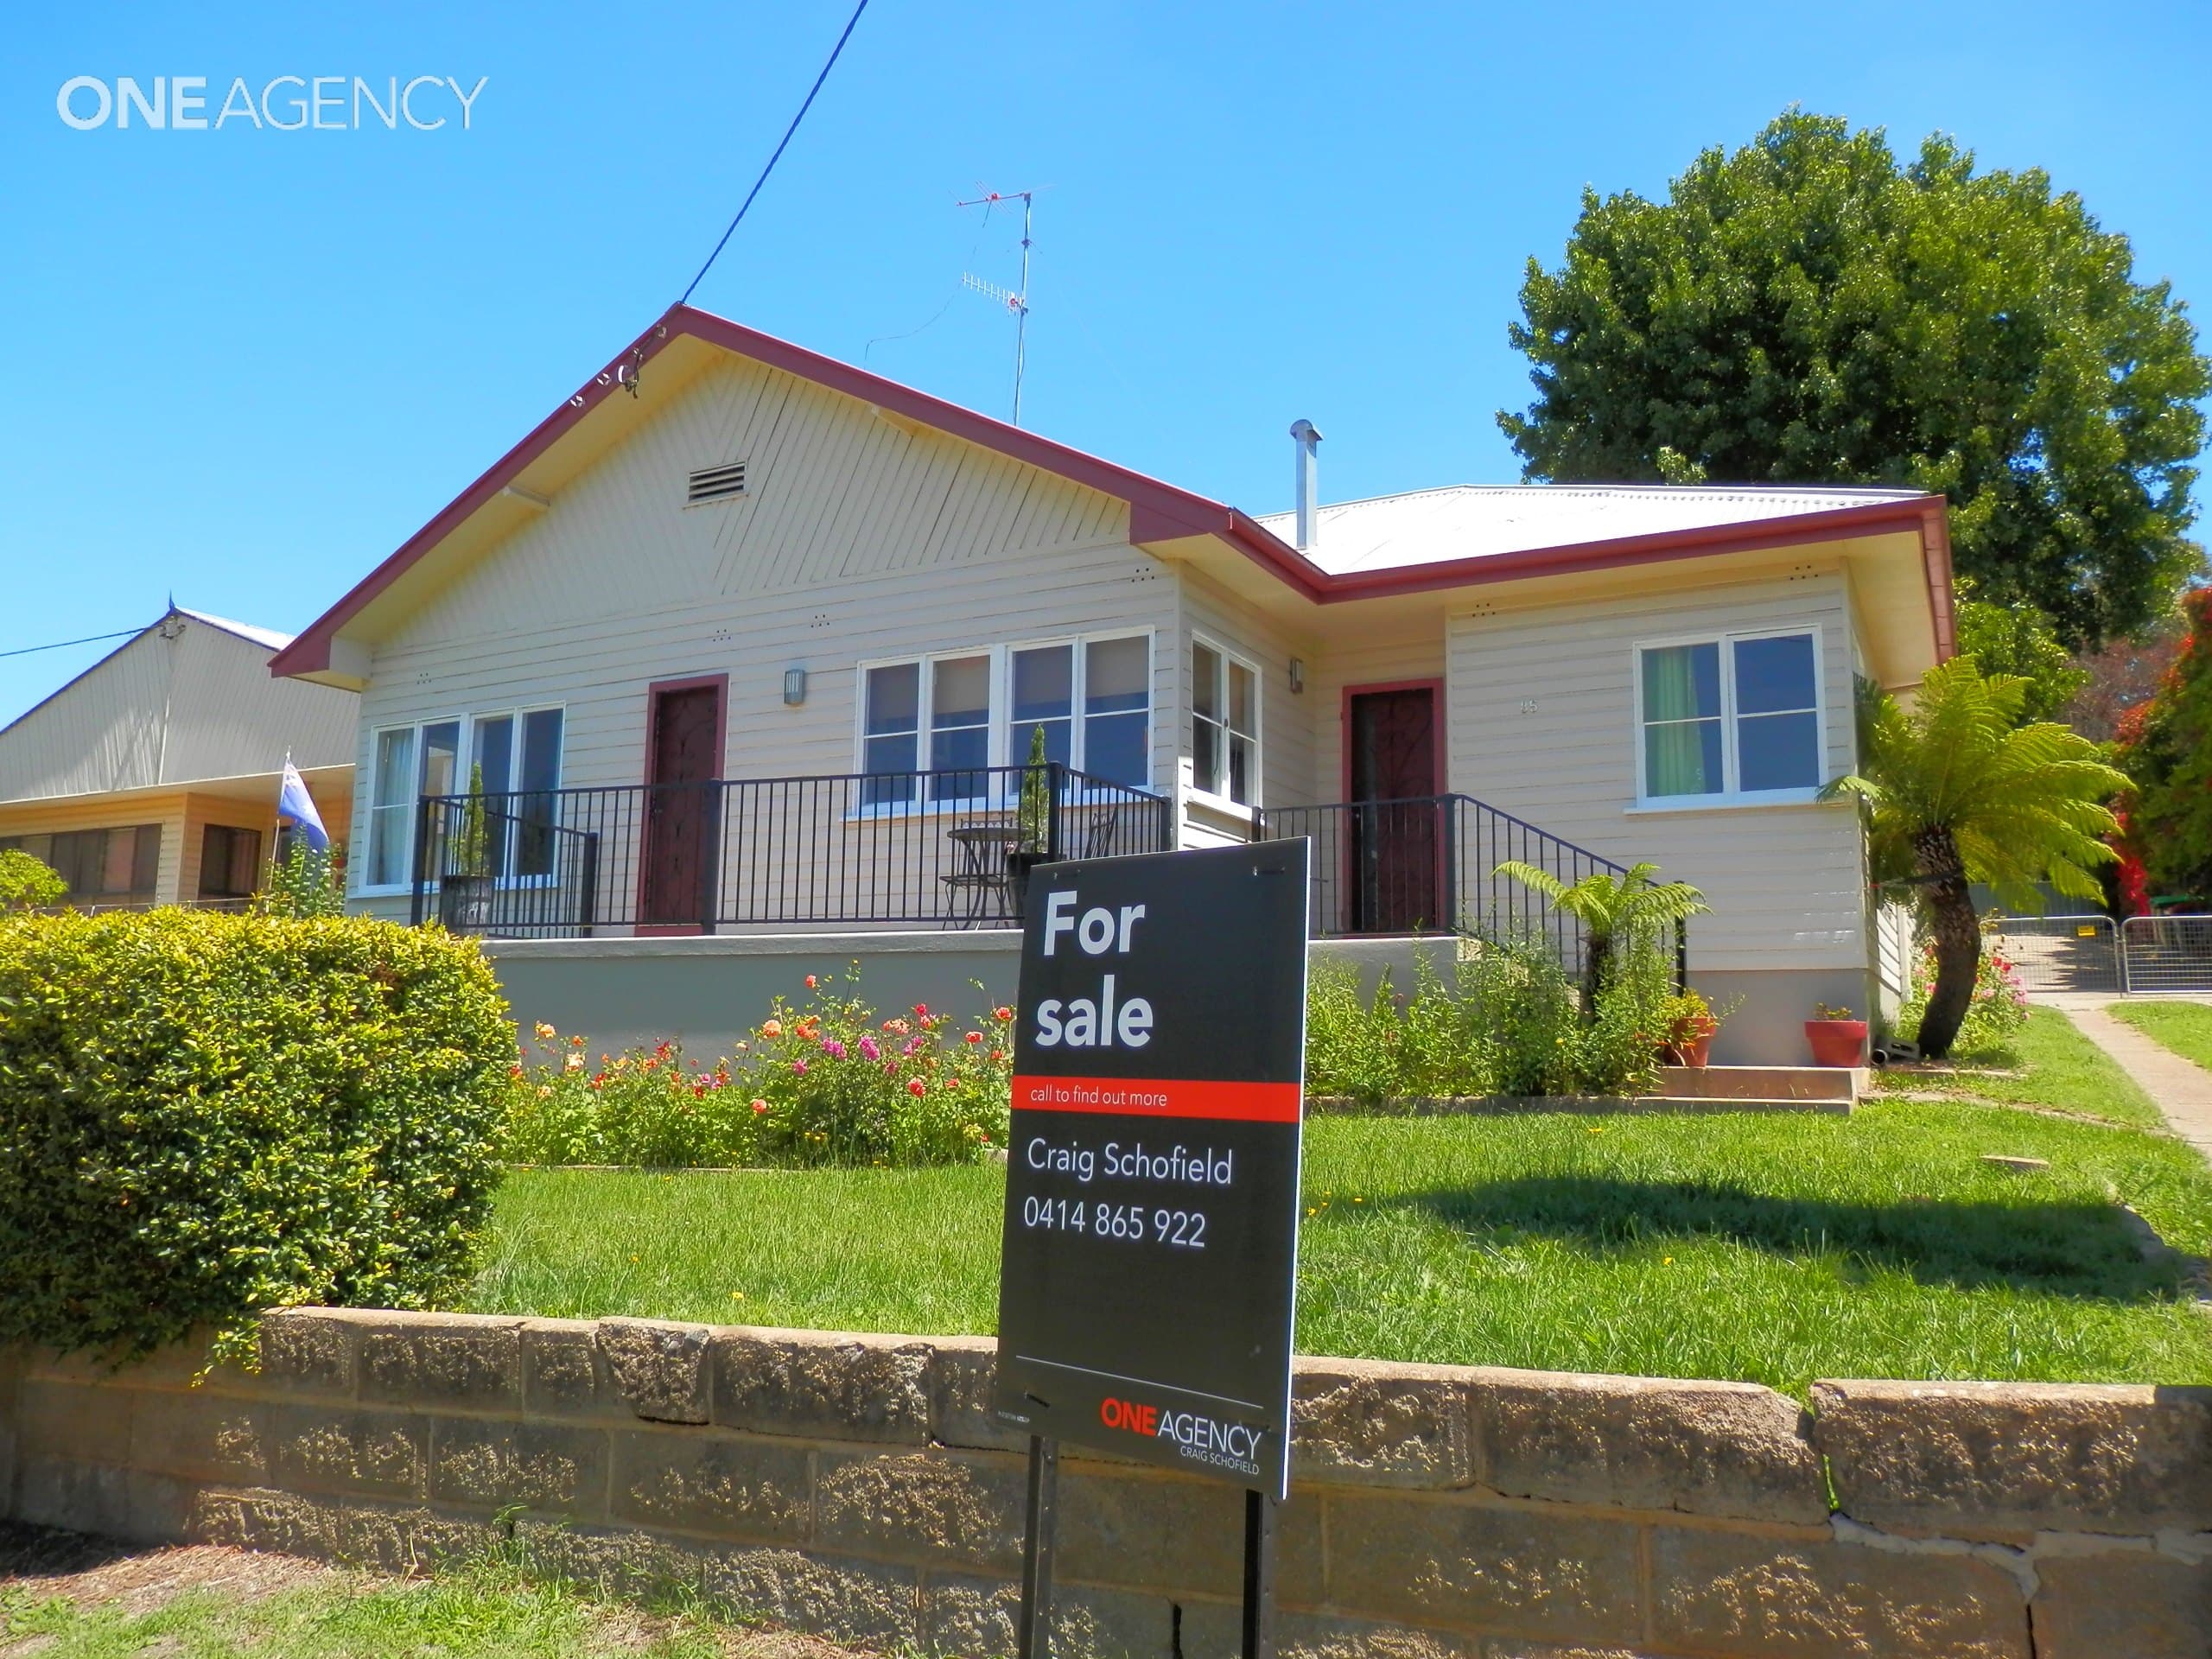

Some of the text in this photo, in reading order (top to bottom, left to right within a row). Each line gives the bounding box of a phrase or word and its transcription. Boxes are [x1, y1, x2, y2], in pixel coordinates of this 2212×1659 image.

[1044, 890, 1146, 957] For
[1035, 974, 1154, 1047] sale
[1030, 1084, 1167, 1107] call to find out more
[1027, 1137, 1233, 1185] Craig Schofield
[1024, 1196, 1207, 1248] 0414 865 922
[1180, 1446, 1260, 1475] CRAIG SCHOFIELD
